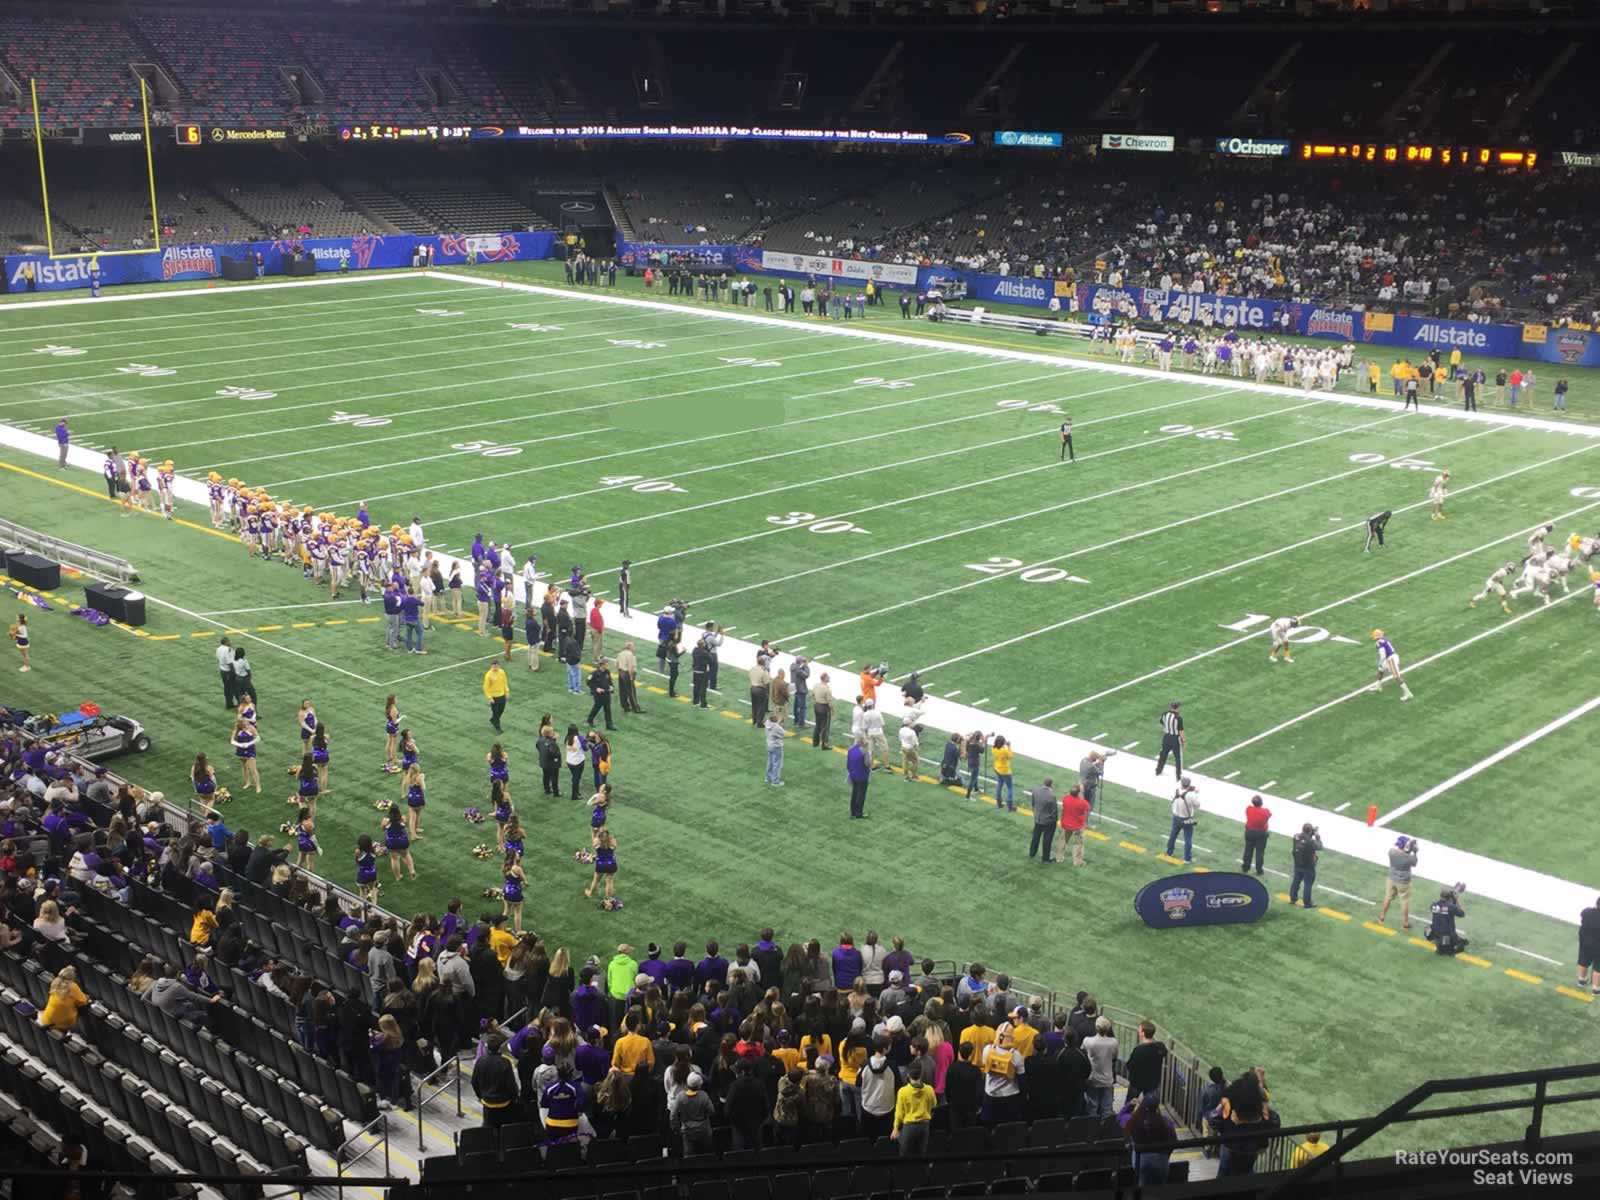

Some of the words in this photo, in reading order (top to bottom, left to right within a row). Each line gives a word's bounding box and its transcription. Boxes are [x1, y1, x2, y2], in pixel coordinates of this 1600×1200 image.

[109, 132, 141, 141] verizon
[188, 127, 198, 142] 6
[226, 129, 287, 140] Mercedes-Benz
[582, 126, 604, 135] 2016
[1017, 134, 1053, 145] Allstate
[1125, 136, 1167, 149] Chevron
[1229, 138, 1285, 155] Ochsner
[1367, 147, 1375, 160] 2
[1385, 147, 1397, 160] 10
[1527, 153, 1536, 166] 2
[1562, 151, 1593, 165] Winn
[163, 246, 213, 261] Allstate
[11, 258, 100, 284] Allstate
[994, 281, 1045, 300] Allstate
[1310, 308, 1353, 324] Allstate
[1414, 324, 1487, 347] Allstate
[451, 440, 523, 456] 50
[600, 475, 675, 493] 40
[766, 511, 854, 534] 30
[963, 556, 1069, 583] 20
[1218, 613, 1330, 643] 10
